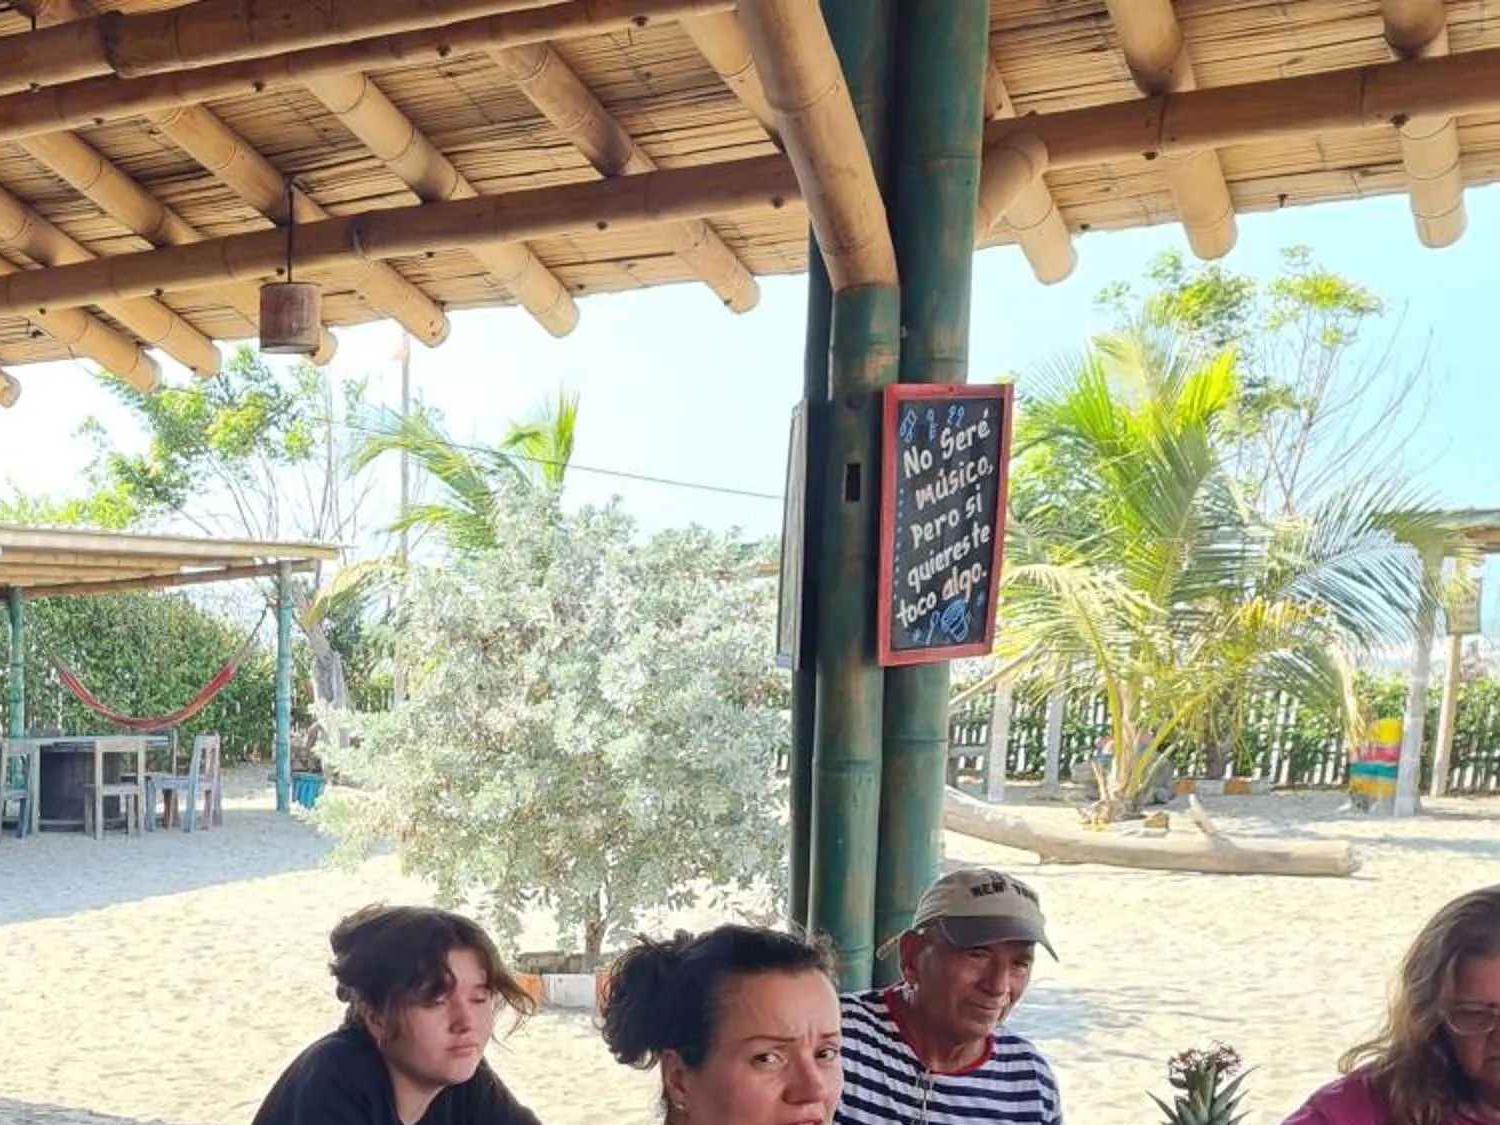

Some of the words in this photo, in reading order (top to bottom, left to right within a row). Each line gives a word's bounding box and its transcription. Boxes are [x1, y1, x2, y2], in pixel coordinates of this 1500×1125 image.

[903, 445, 933, 478] No
[940, 407, 991, 458] Seré
[915, 455, 995, 511] músico,
[910, 509, 960, 549] Pero
[965, 485, 983, 519] si
[896, 592, 937, 629] toco
[941, 562, 988, 604] algo.
